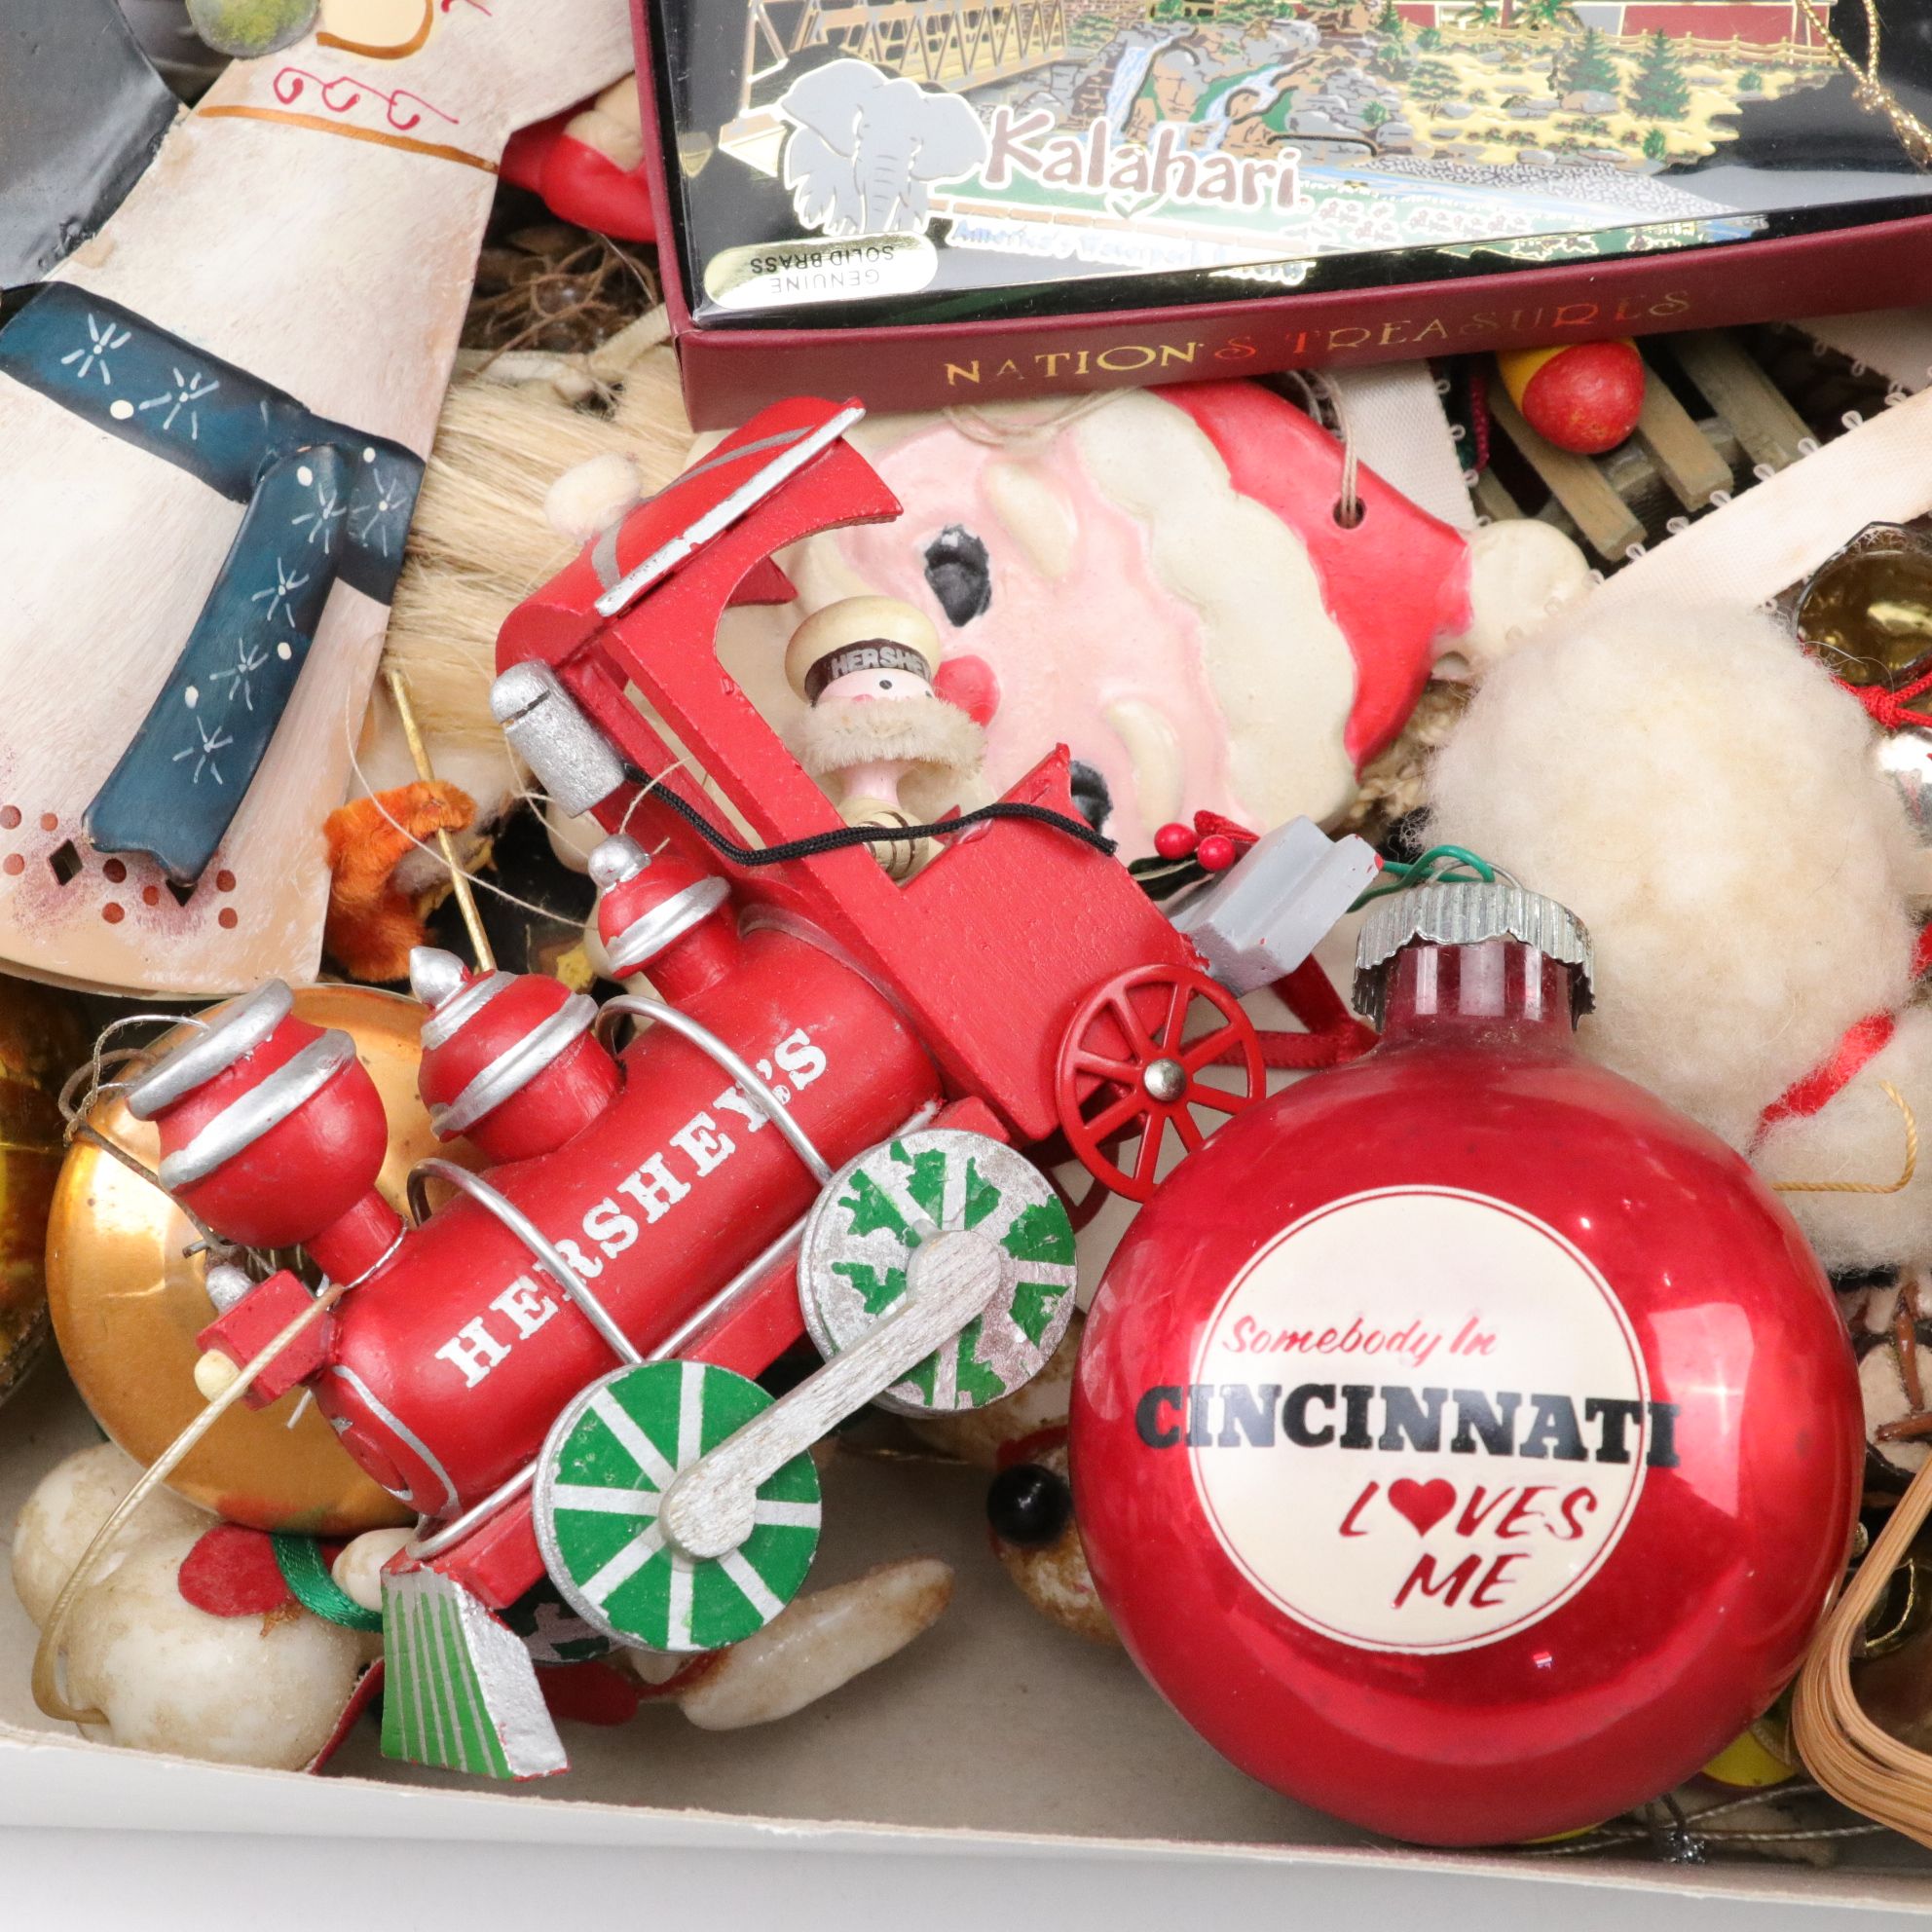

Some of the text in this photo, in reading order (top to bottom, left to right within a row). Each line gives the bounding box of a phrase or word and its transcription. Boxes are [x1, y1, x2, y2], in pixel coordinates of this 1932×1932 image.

[985, 107, 1301, 208] Kalahari
[751, 245, 894, 275] SOLID BRASS
[770, 268, 880, 293] GENUINE
[1285, 290, 1690, 354] TREASURES
[1222, 1315, 1497, 1368] Somebody In
[1134, 1383, 1681, 1468] CINCINNATI
[1392, 1552, 1533, 1610] ME
